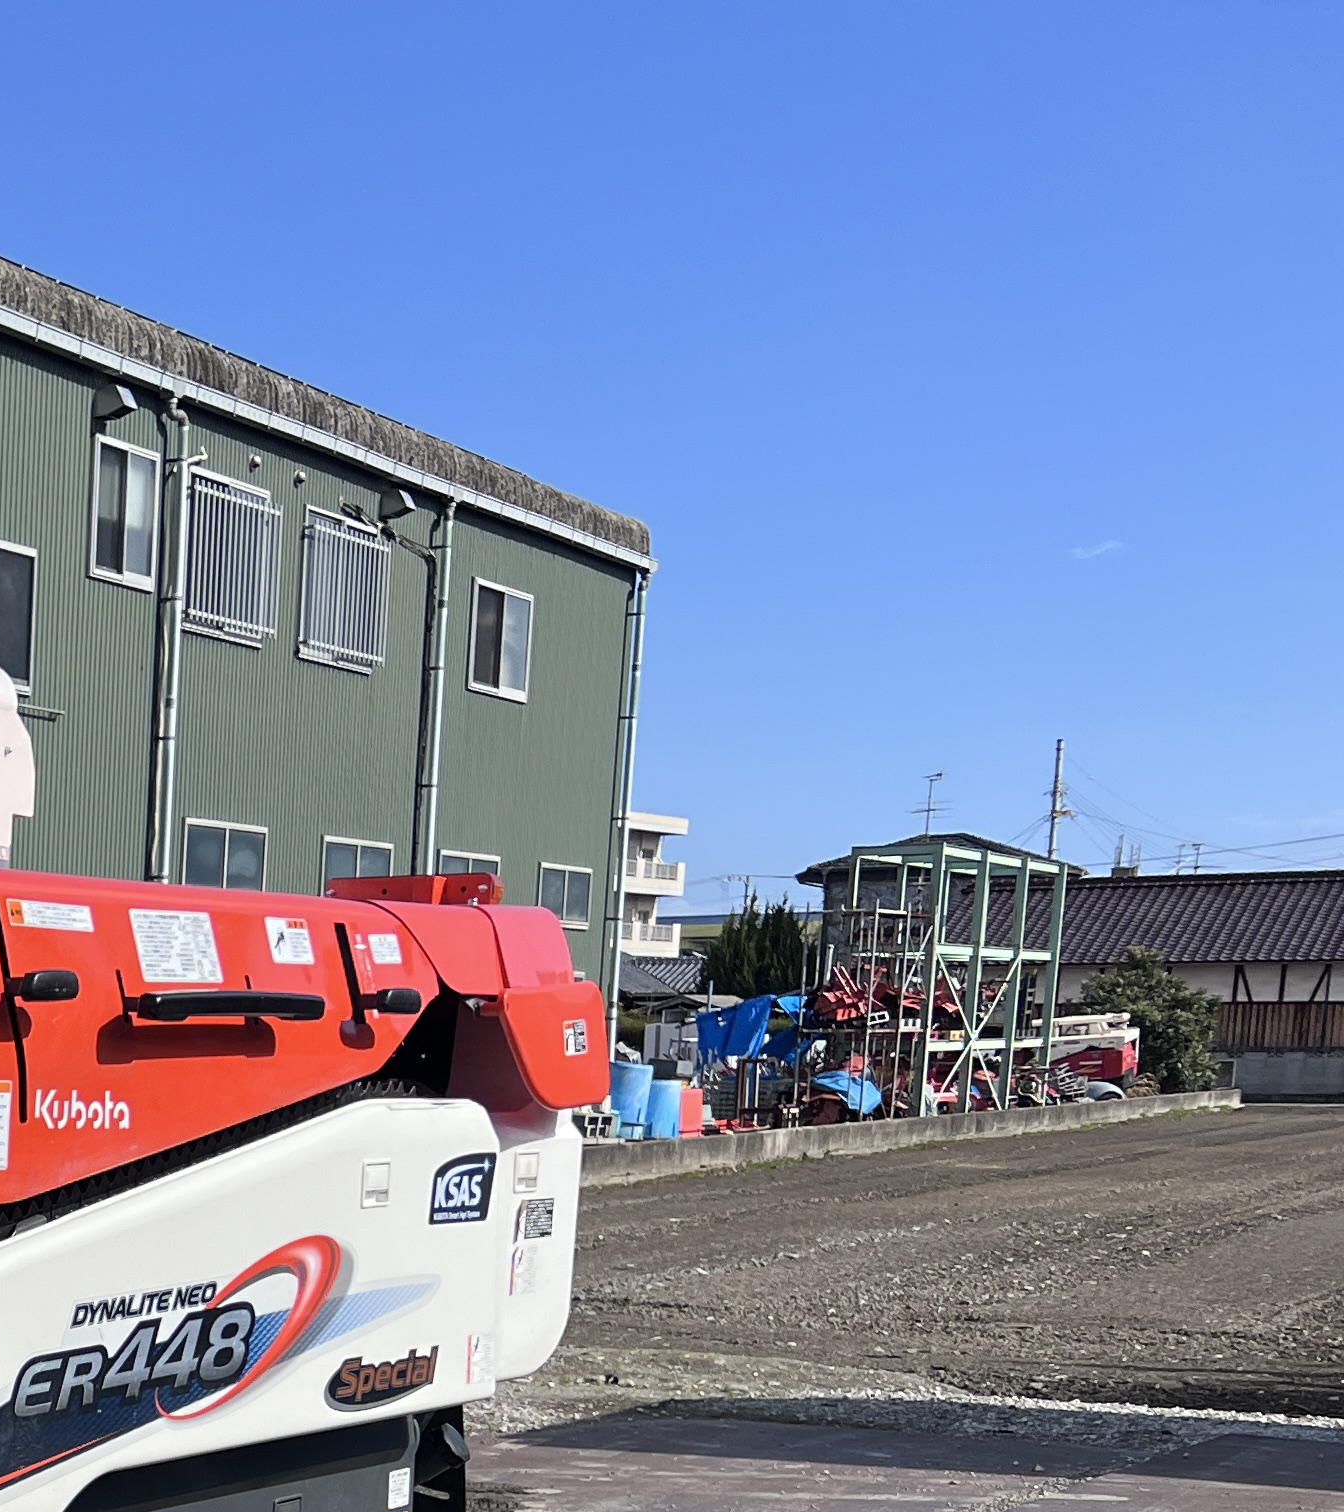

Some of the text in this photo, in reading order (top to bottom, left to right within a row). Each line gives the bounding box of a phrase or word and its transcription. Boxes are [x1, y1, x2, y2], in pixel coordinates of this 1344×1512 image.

[34, 1088, 130, 1130] Kubota
[434, 1175, 483, 1208] KSAS
[71, 1281, 217, 1329] DYNALITE NEO
[14, 1307, 253, 1418] ER448
[335, 1345, 440, 1403] Special
